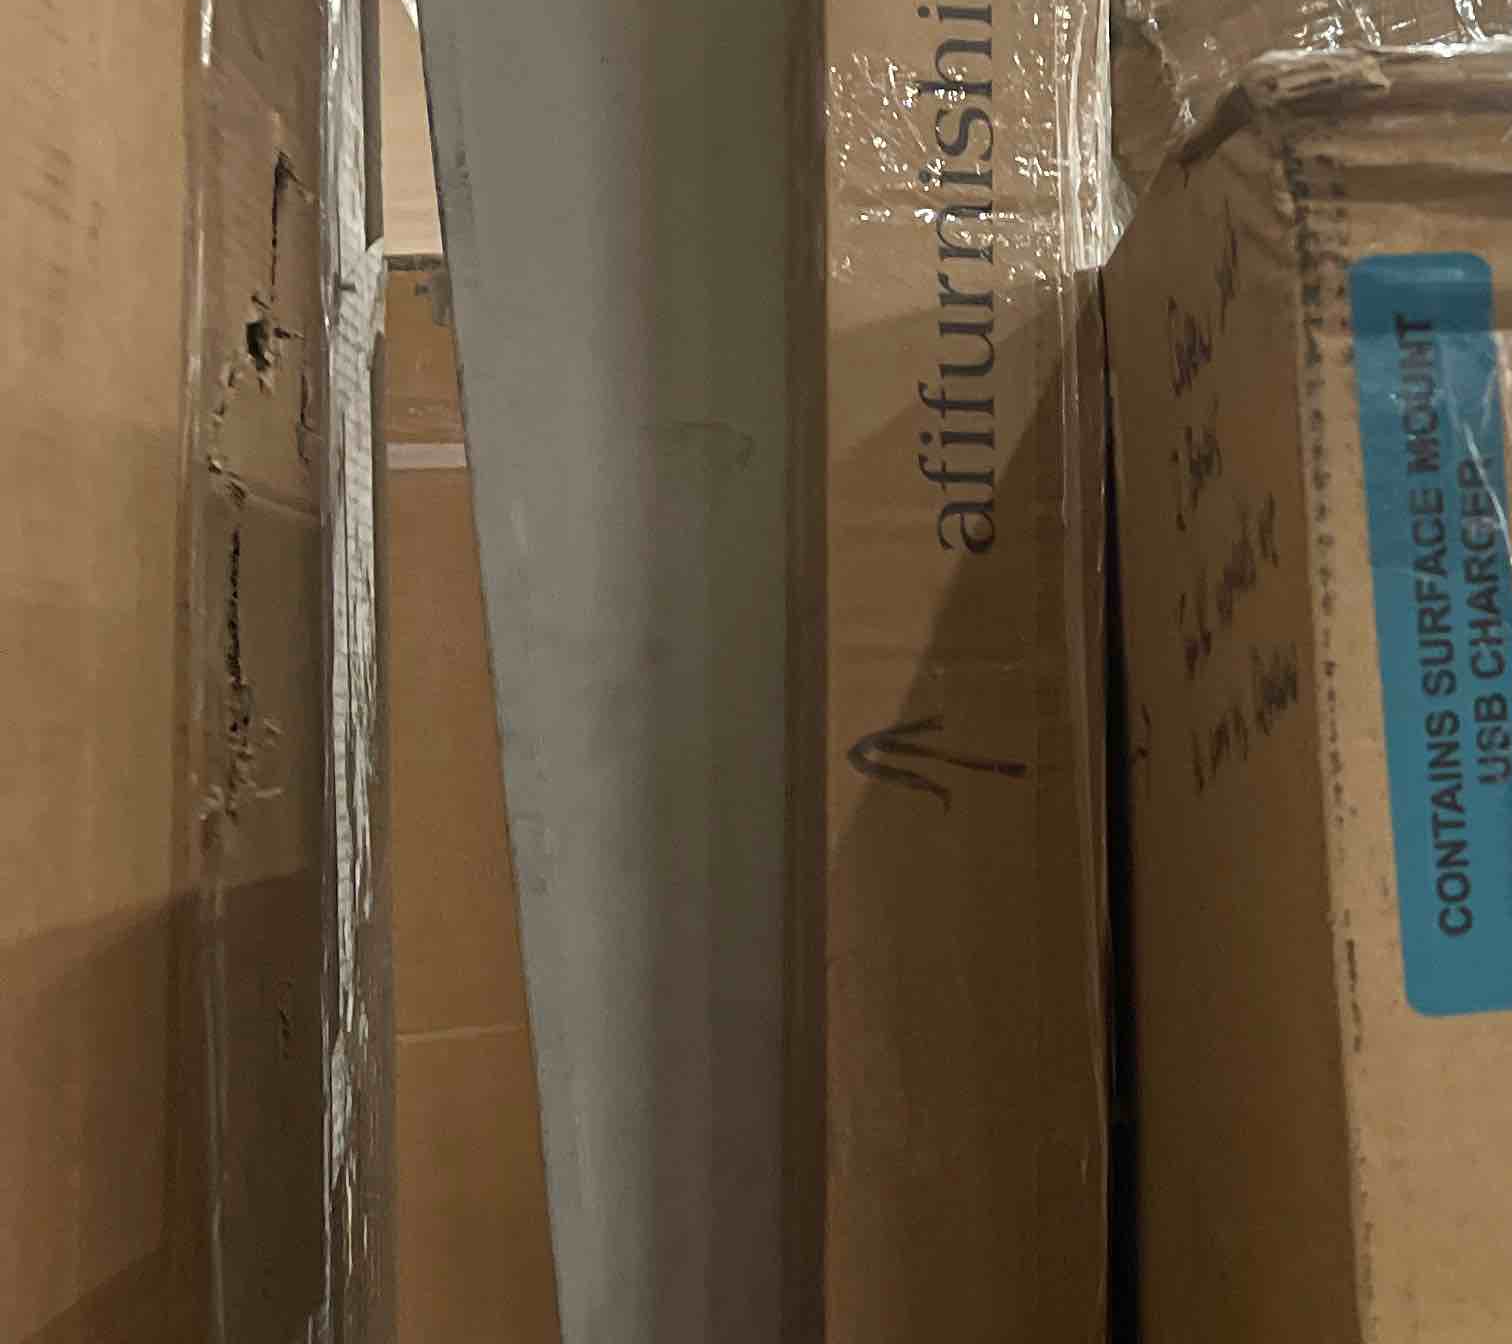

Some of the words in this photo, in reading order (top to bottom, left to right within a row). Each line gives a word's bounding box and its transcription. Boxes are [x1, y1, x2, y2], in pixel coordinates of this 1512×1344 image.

[1396, 314, 1440, 474] MOUNT
[1408, 487, 1457, 697] SURFACE
[1460, 457, 1506, 679] CHARGER
[1424, 709, 1474, 936] CONTAINS
[1475, 694, 1512, 783] USB
